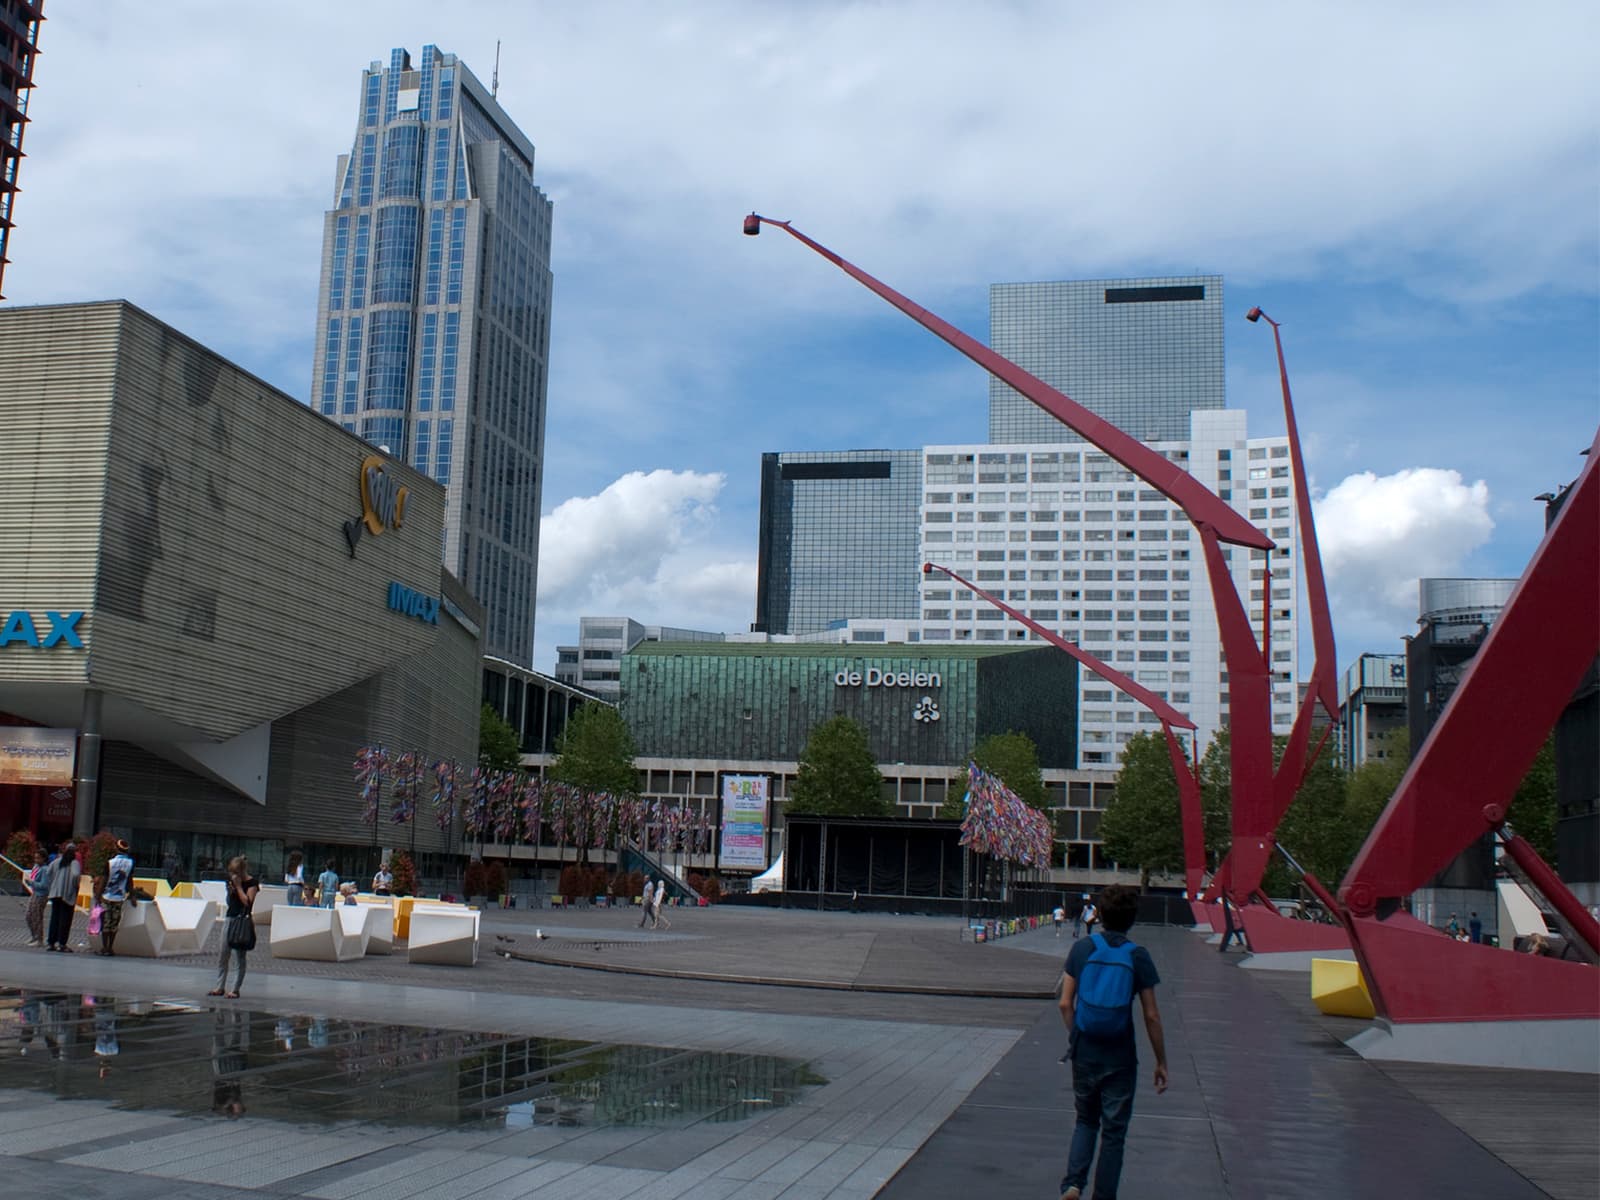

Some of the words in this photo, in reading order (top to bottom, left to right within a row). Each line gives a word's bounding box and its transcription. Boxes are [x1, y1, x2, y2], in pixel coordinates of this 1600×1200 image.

[389, 582, 440, 624] IMAX
[834, 667, 861, 687] de
[866, 667, 942, 688] Doelen
